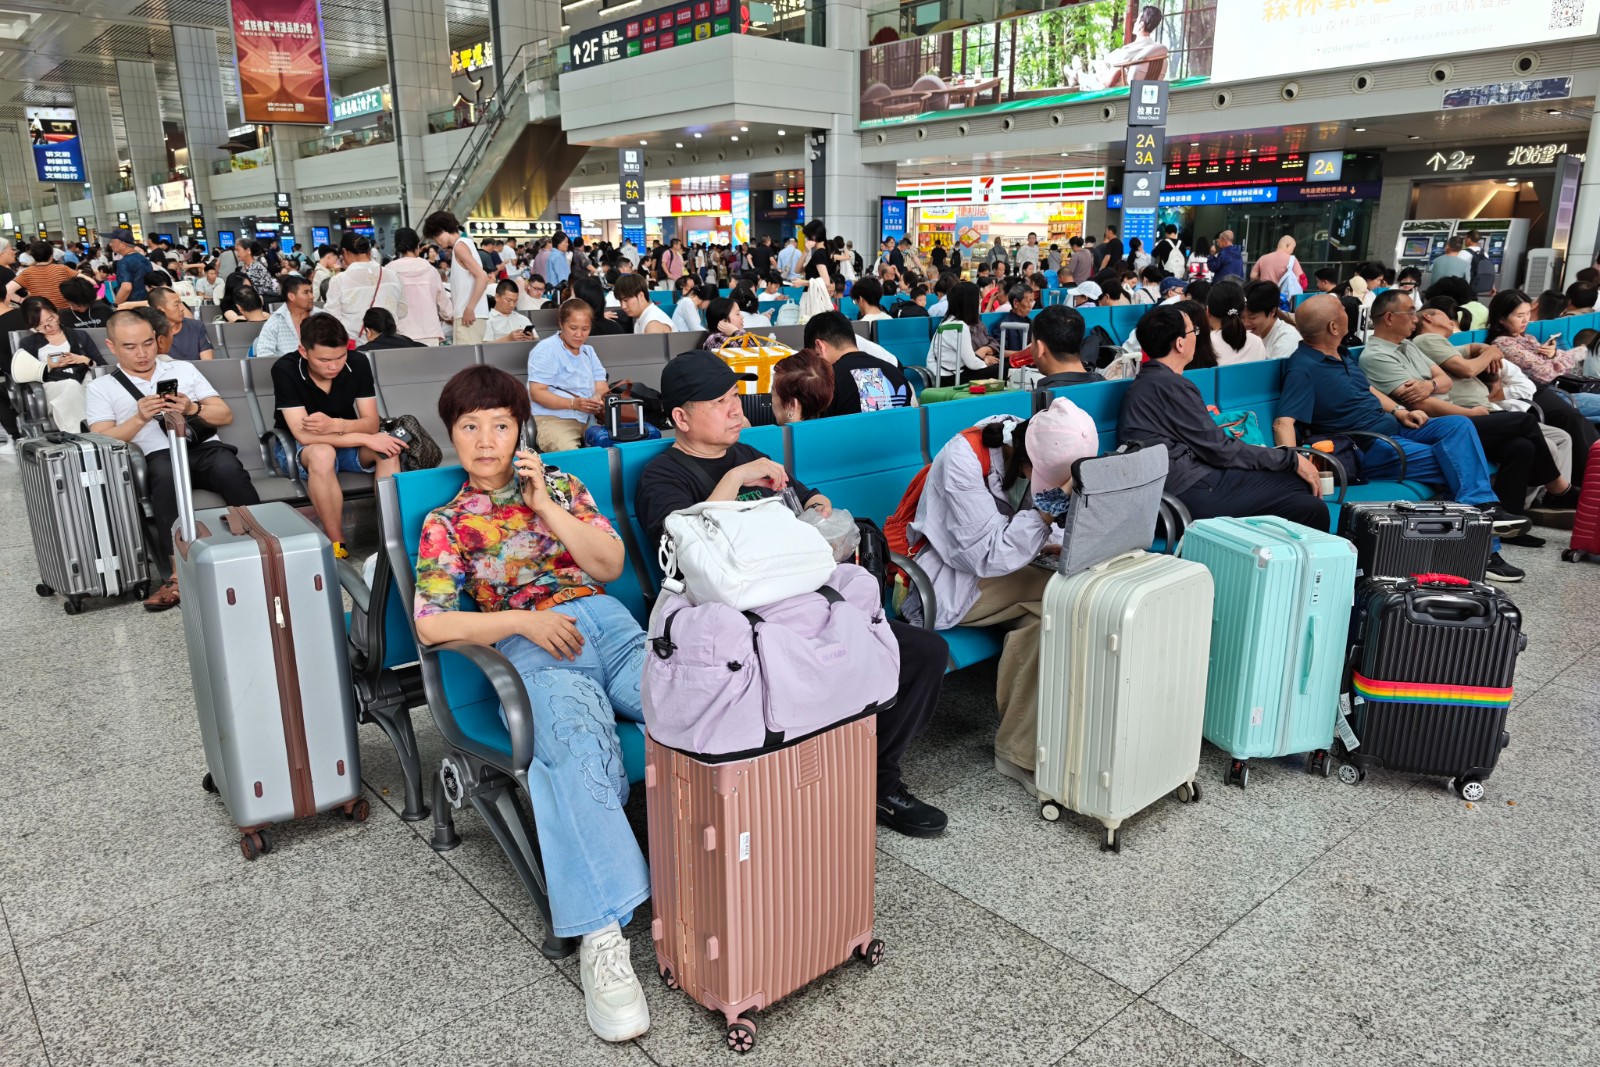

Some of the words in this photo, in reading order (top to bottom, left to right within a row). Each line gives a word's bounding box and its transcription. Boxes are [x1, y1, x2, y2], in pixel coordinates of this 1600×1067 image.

[582, 38, 599, 63] 2F
[1137, 106, 1160, 115] 检票口
[1135, 133, 1156, 148] 2A
[1135, 151, 1154, 165] 3A
[1447, 150, 1475, 171] 2F
[1313, 159, 1335, 175] 2A
[625, 180, 639, 189] 4A
[626, 190, 639, 199] 5A
[775, 193, 785, 205] 5A
